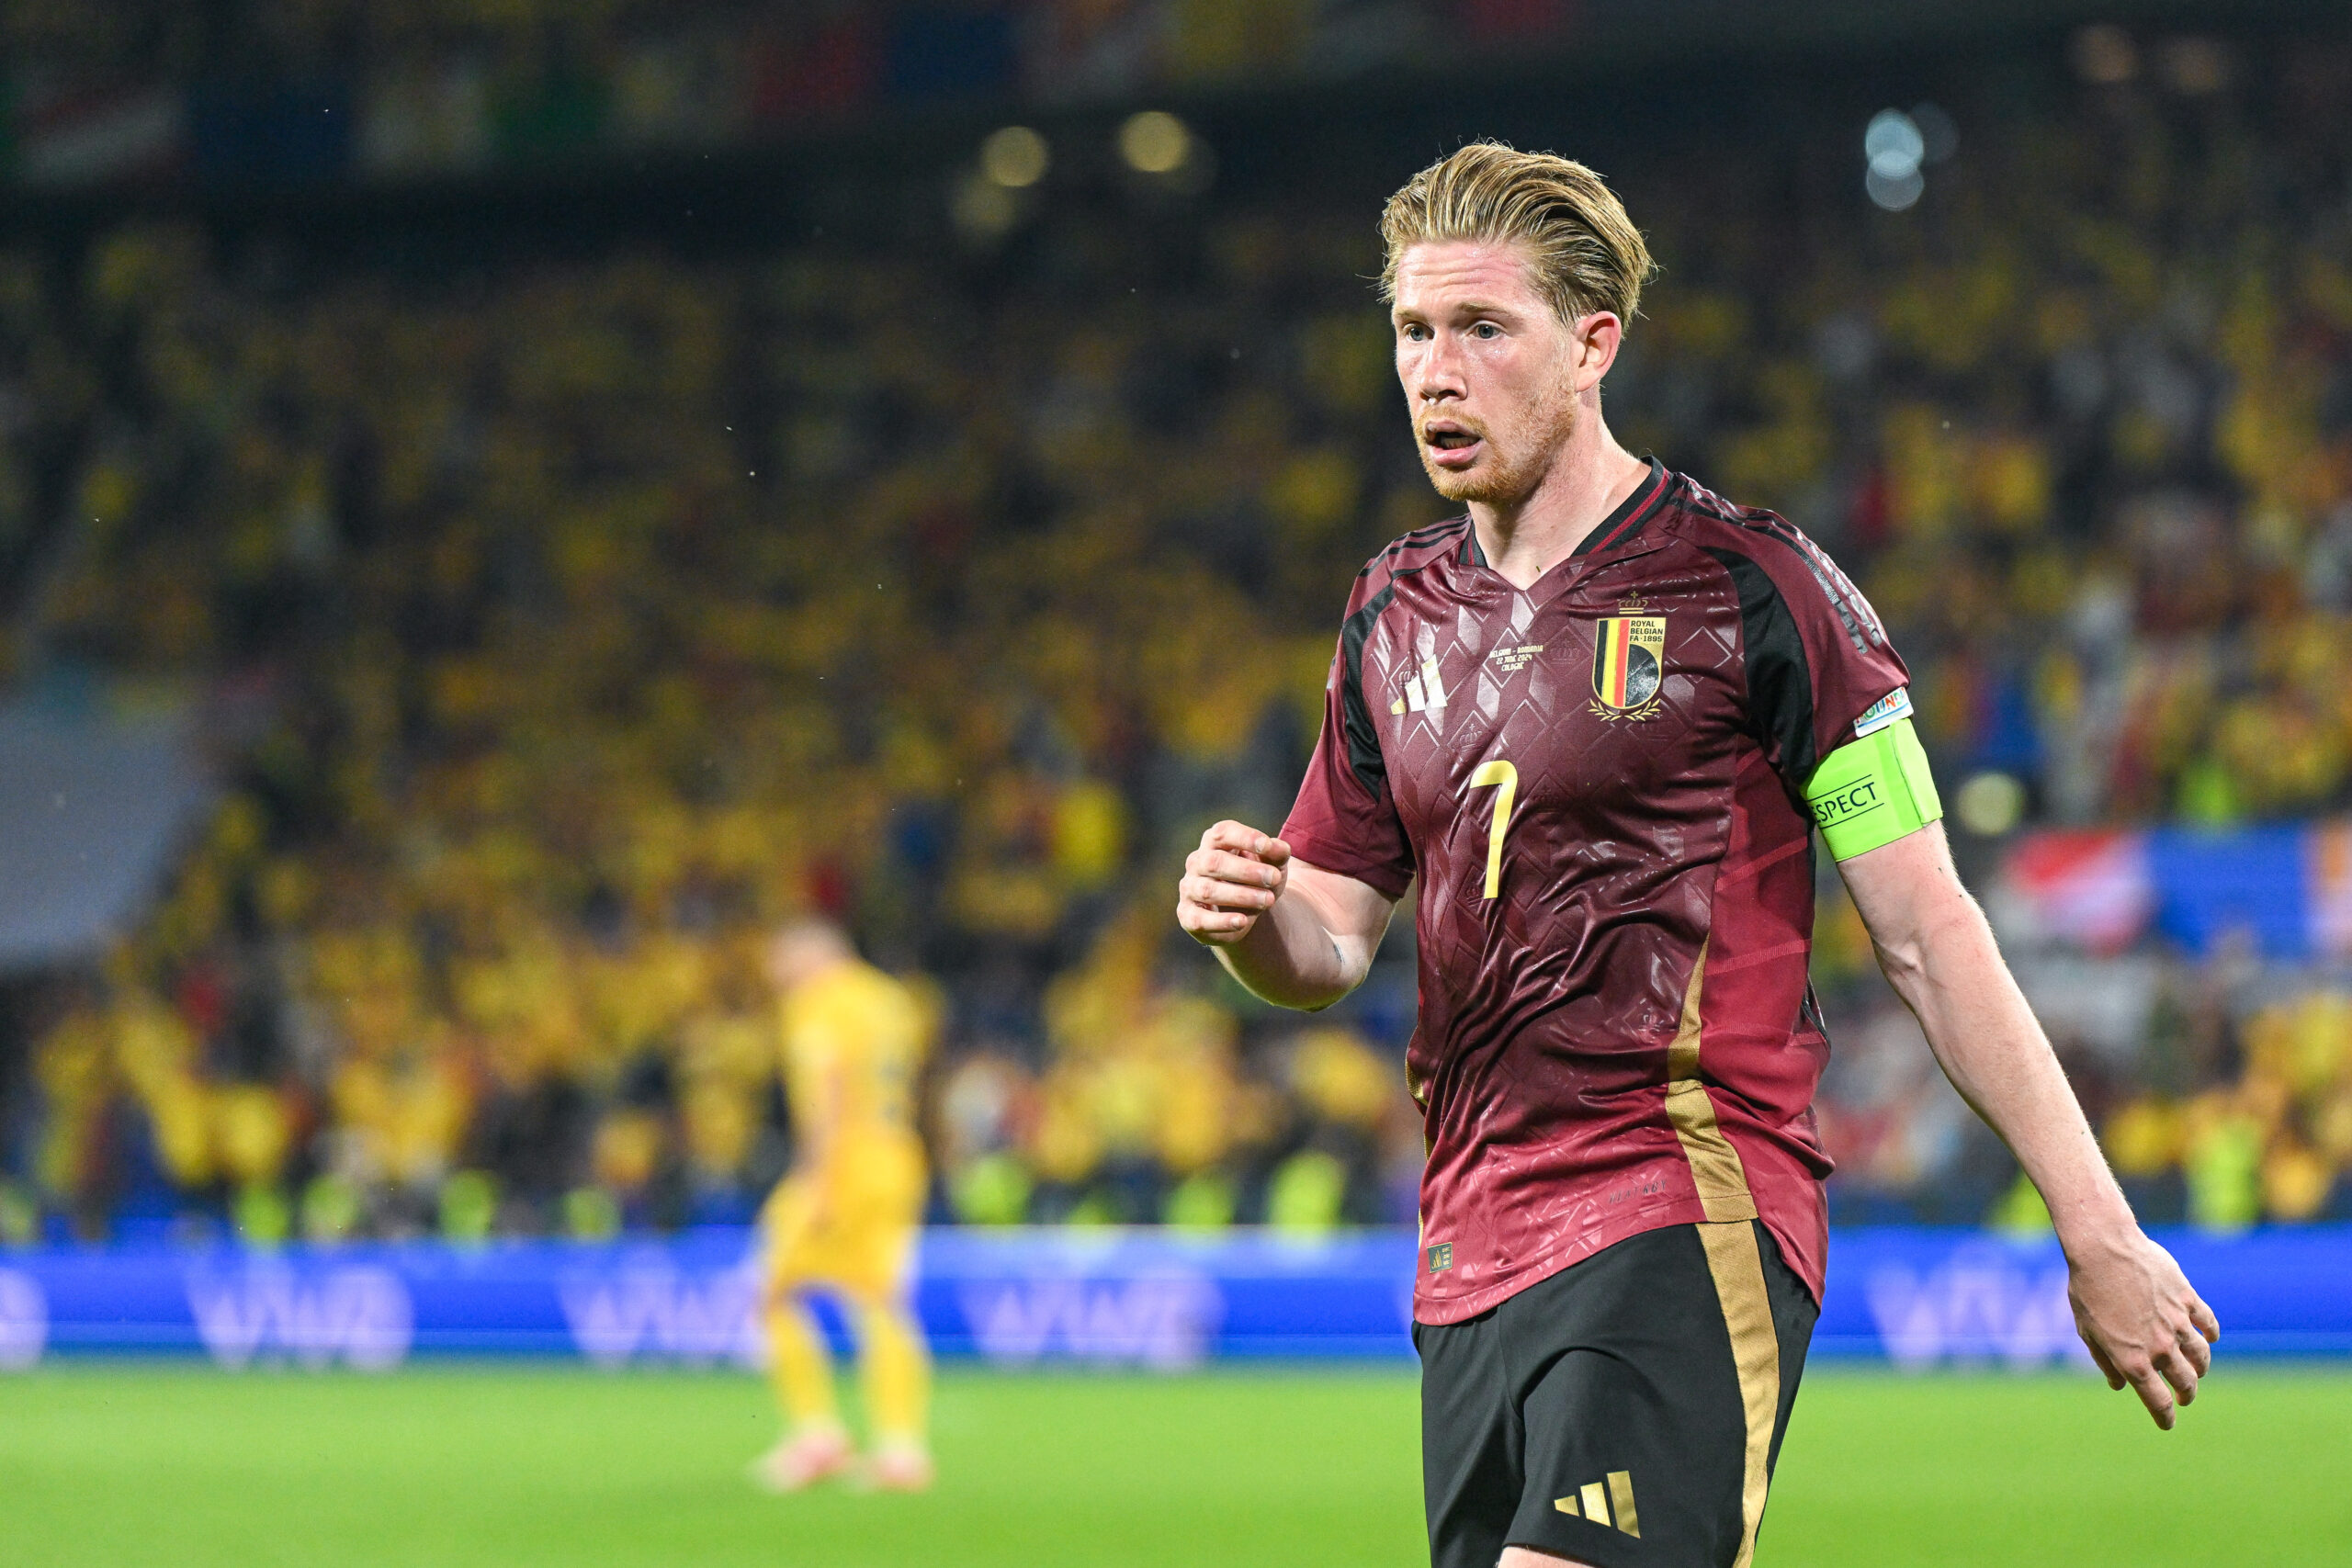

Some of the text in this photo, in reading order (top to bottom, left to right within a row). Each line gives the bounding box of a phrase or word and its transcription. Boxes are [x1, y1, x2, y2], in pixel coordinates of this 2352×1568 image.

[1518, 653, 1532, 662] 2024
[1810, 782, 1877, 823] ESPECT
[1469, 760, 1519, 900] 7
